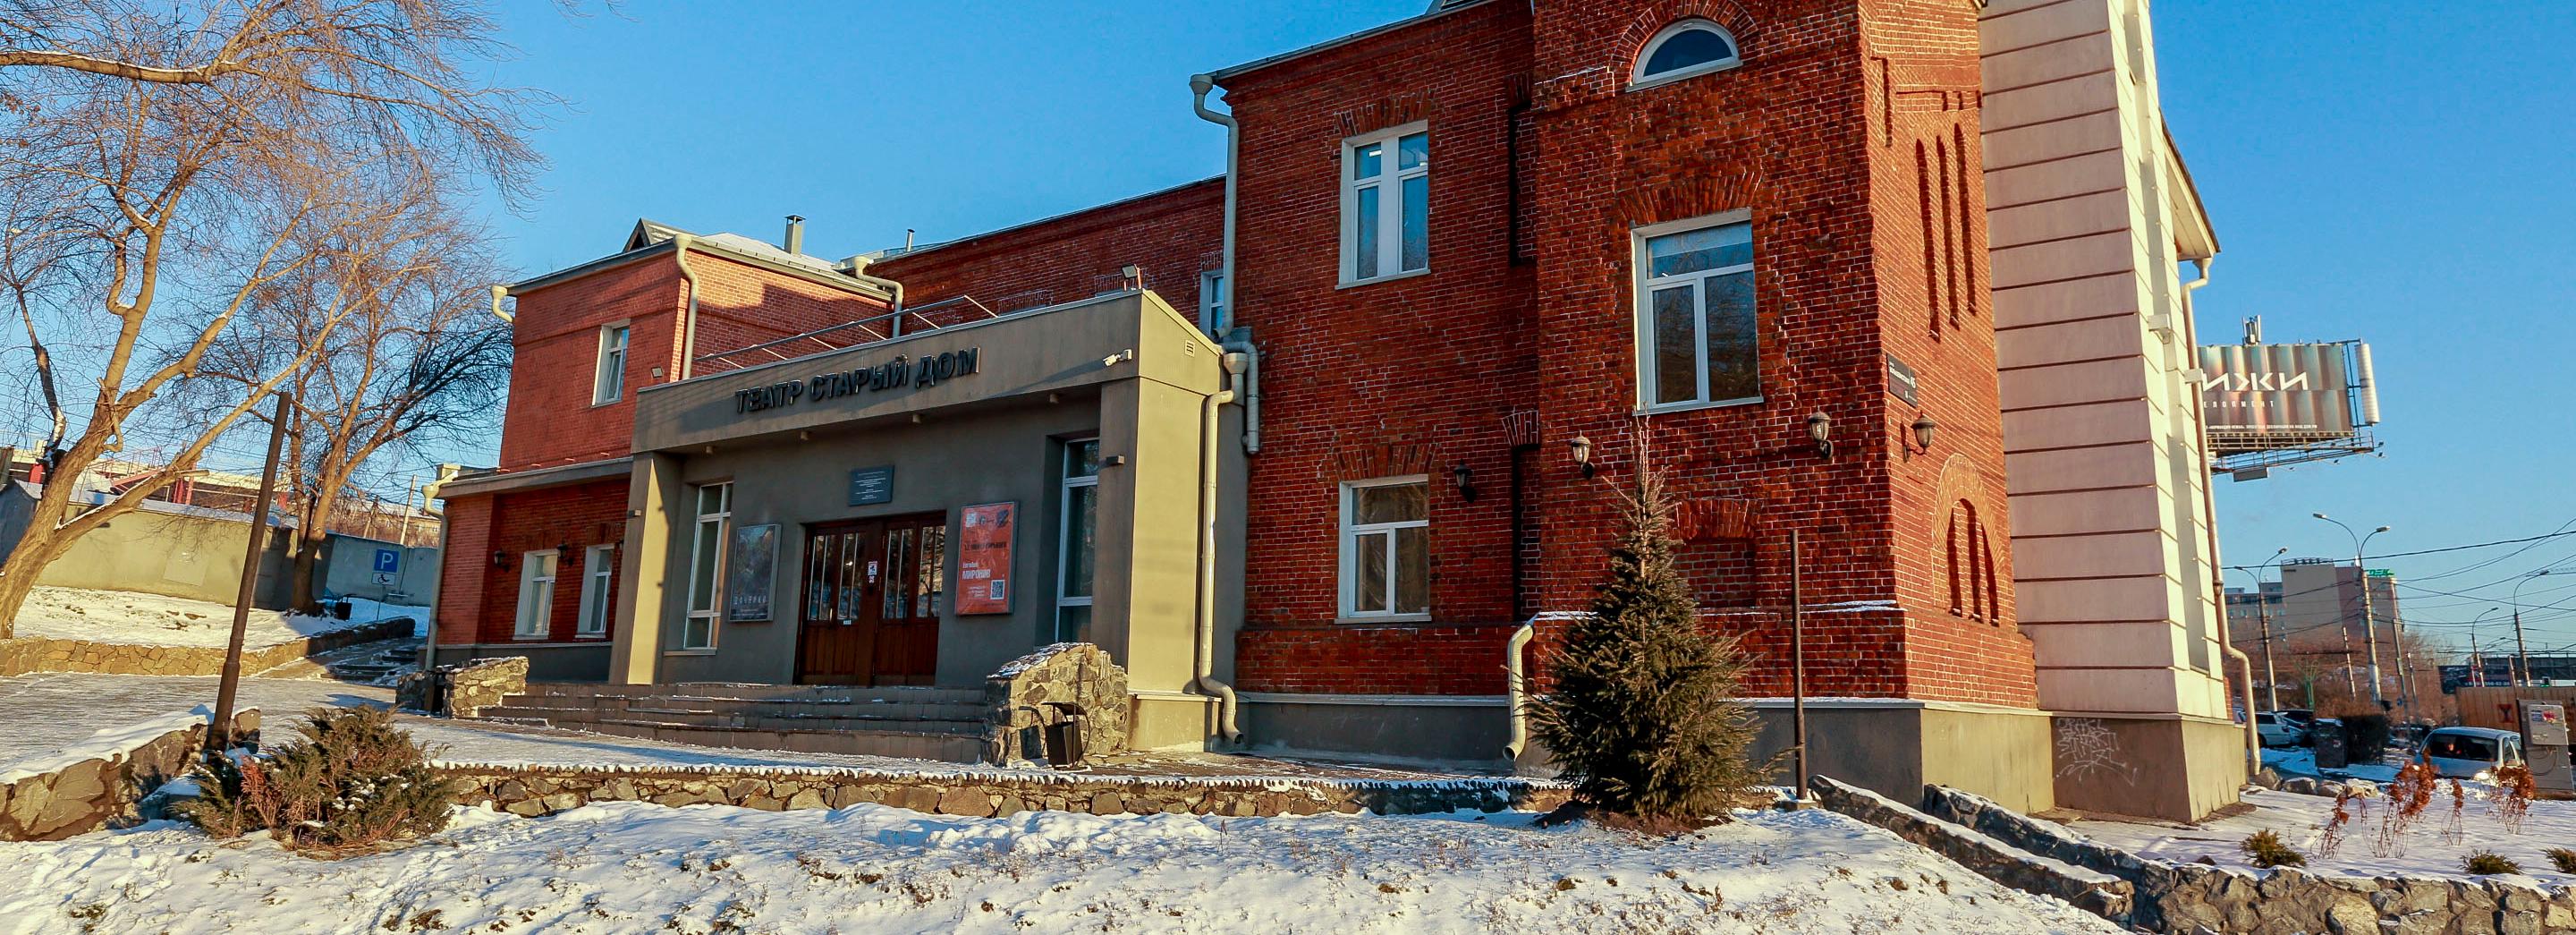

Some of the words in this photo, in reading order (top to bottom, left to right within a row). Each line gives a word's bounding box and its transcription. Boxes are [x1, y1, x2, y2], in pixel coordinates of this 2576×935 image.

[734, 379, 803, 413] ТЕАТР
[809, 353, 910, 401] СТАРЫЙ
[915, 347, 980, 388] ДОМ
[380, 552, 394, 570] P
